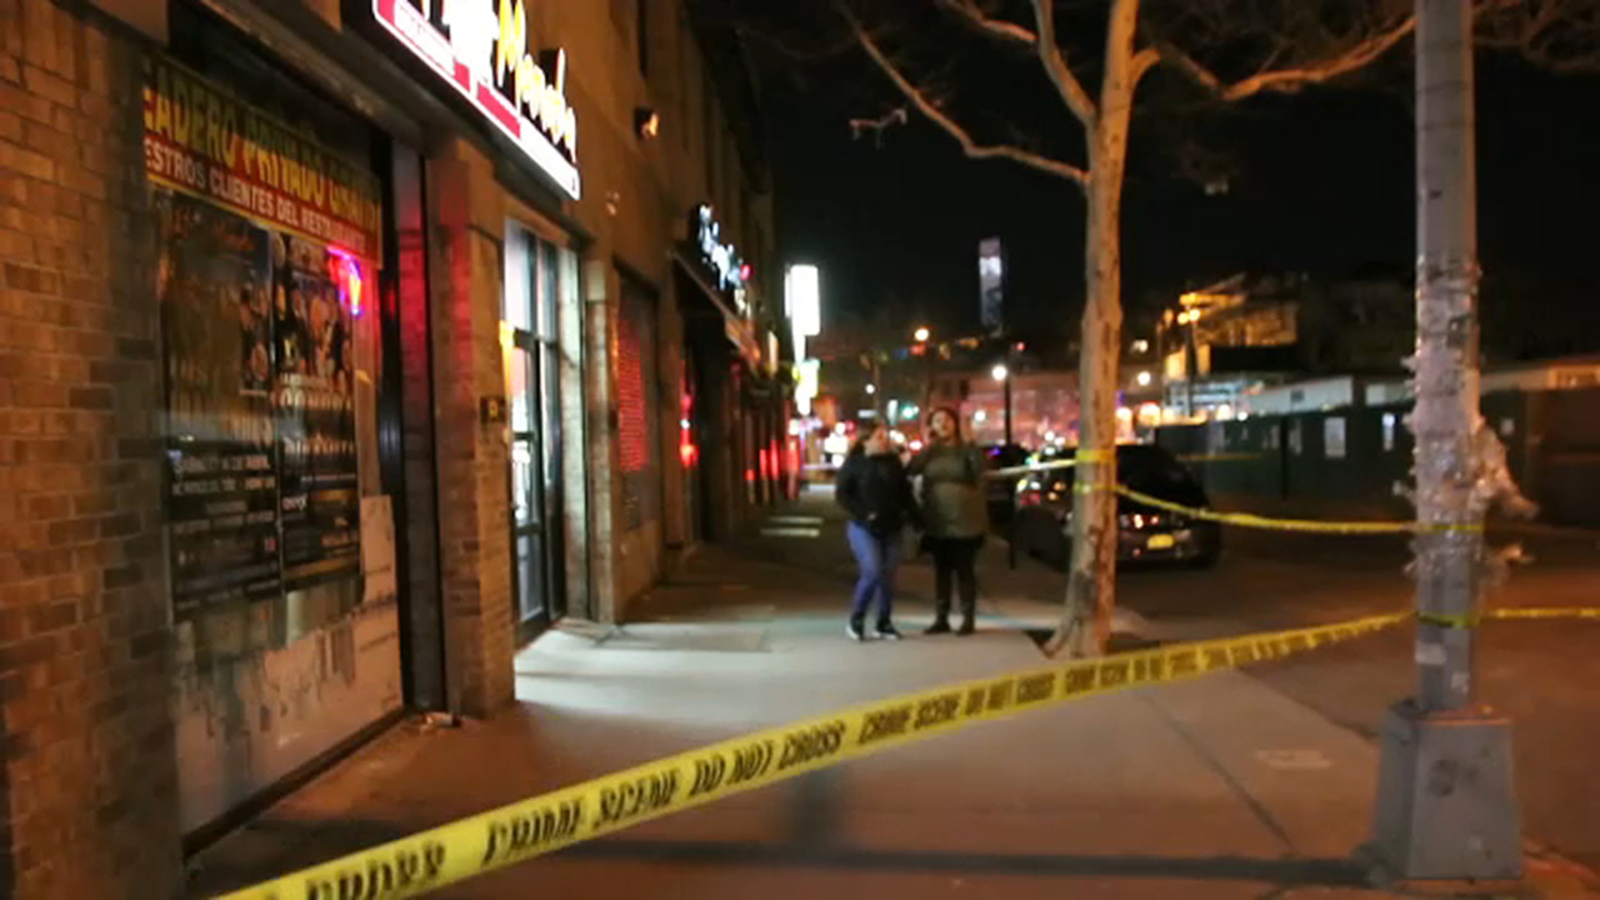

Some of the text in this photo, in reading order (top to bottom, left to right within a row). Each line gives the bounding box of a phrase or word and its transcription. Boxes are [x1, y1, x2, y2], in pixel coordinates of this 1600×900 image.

[209, 166, 275, 218] CLIENTES
[276, 195, 300, 227] DEL
[686, 753, 726, 799] DO
[726, 739, 774, 786] NOT
